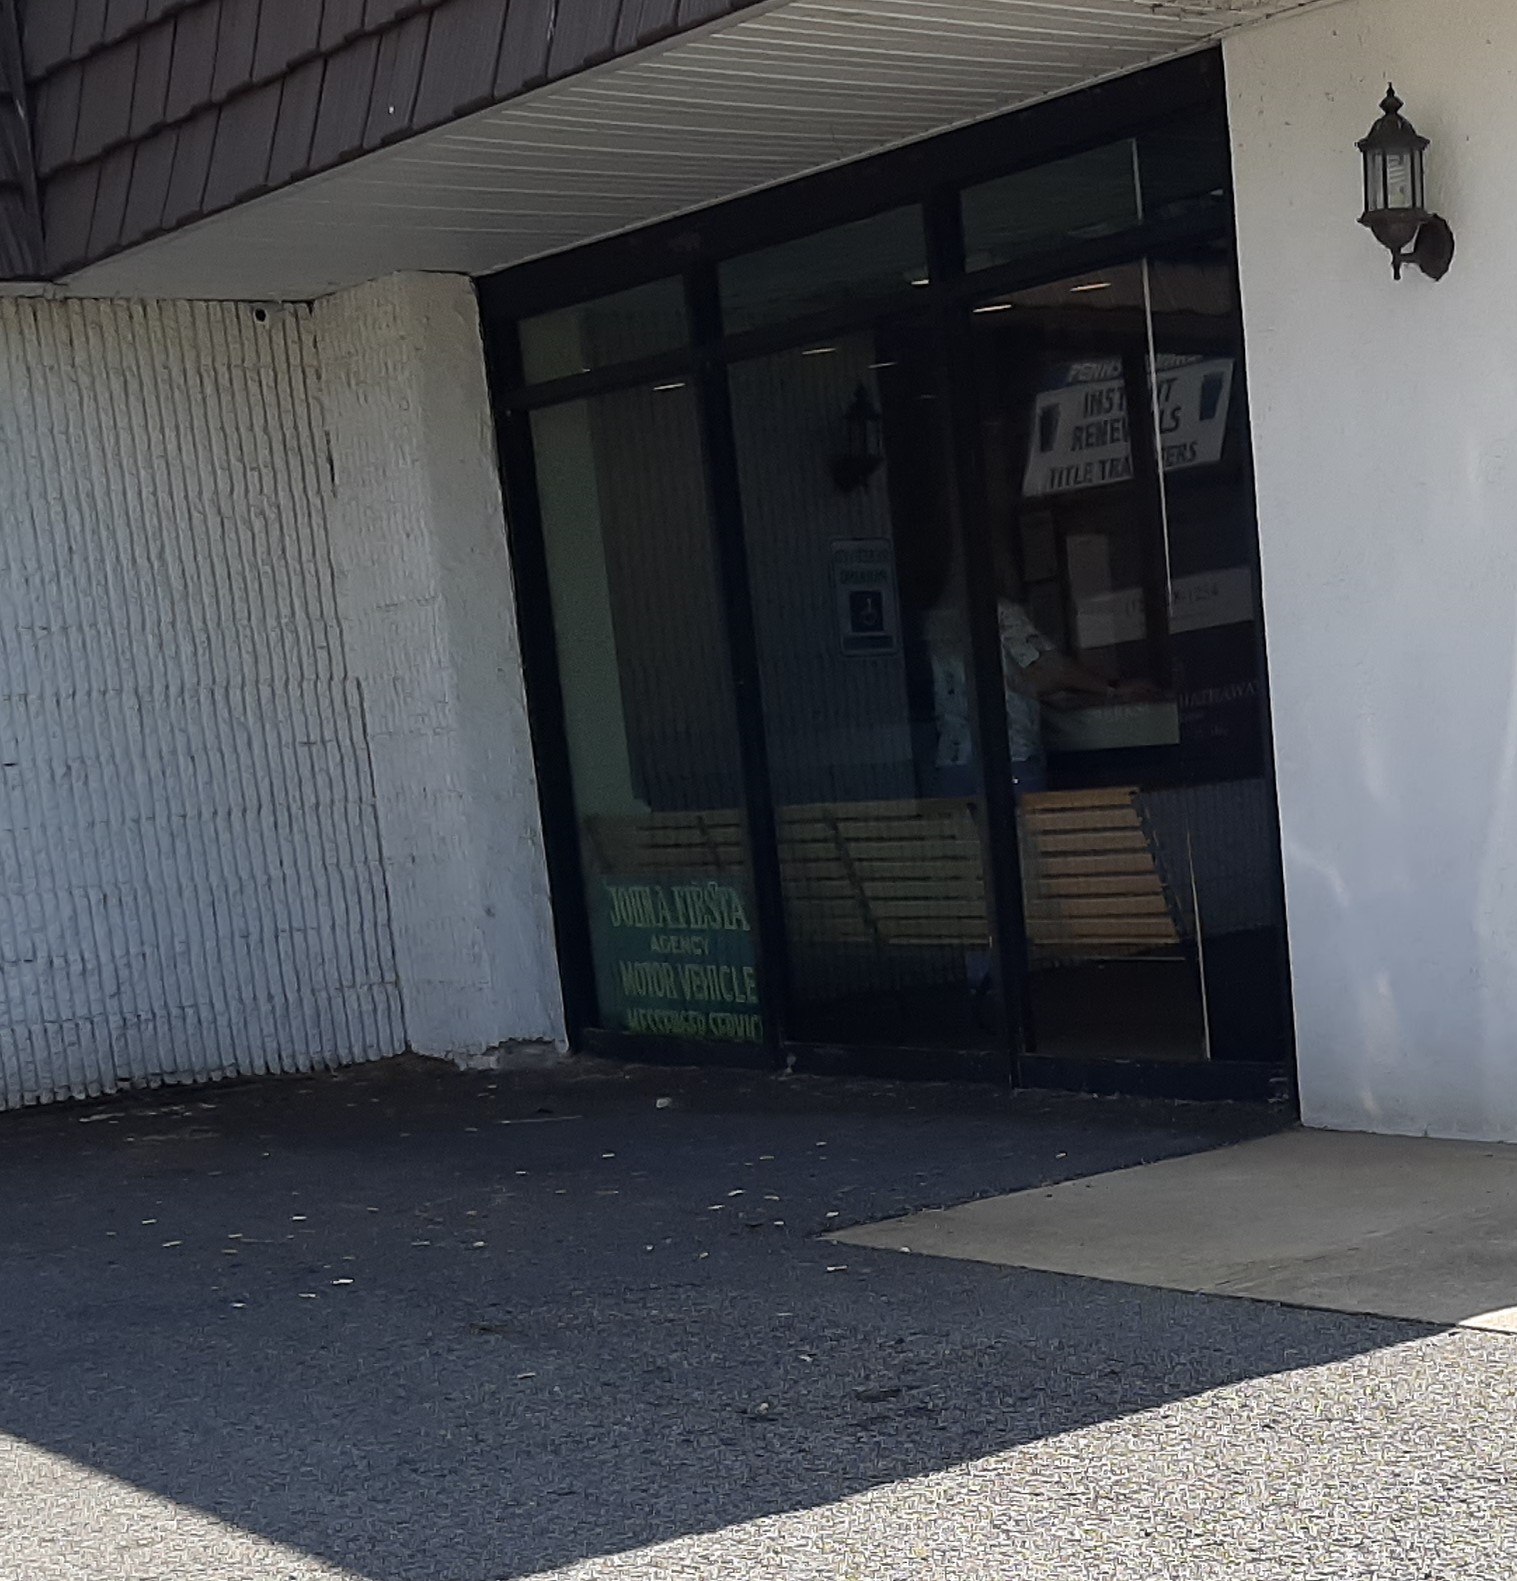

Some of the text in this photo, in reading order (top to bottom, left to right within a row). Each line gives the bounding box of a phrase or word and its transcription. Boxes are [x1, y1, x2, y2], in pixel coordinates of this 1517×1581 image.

[1049, 461, 1093, 490] TITLE
[650, 935, 710, 956] AGENCY
[619, 959, 759, 1004] MOTOR VEHICLE
